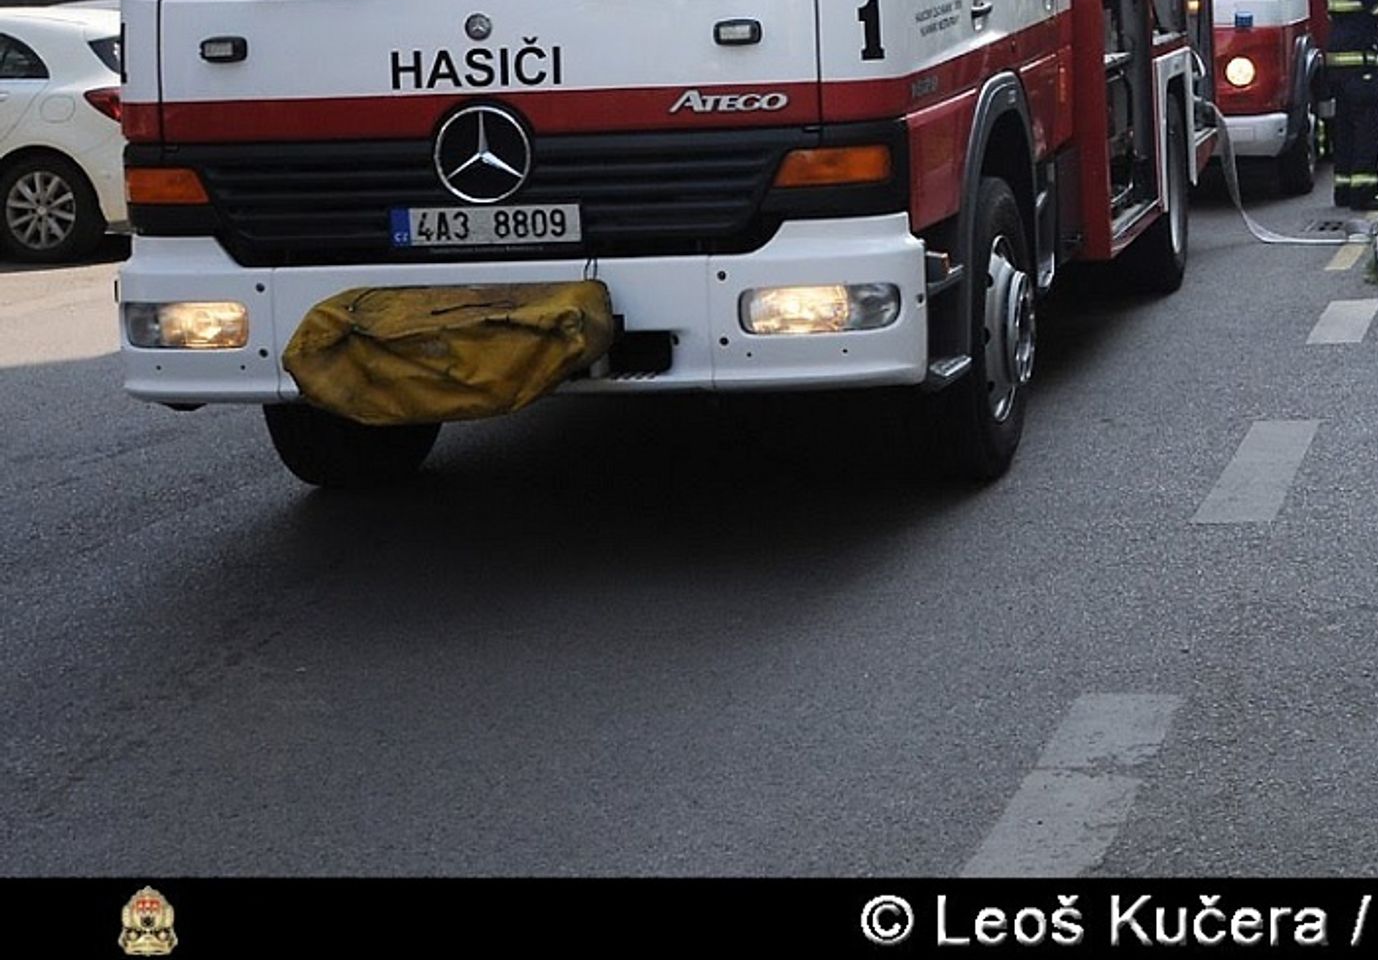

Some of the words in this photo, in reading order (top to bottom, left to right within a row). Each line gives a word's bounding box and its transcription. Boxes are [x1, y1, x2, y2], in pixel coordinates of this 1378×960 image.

[391, 36, 562, 90] HASIČI
[418, 212, 470, 241] 4A3
[493, 209, 567, 239] 8809
